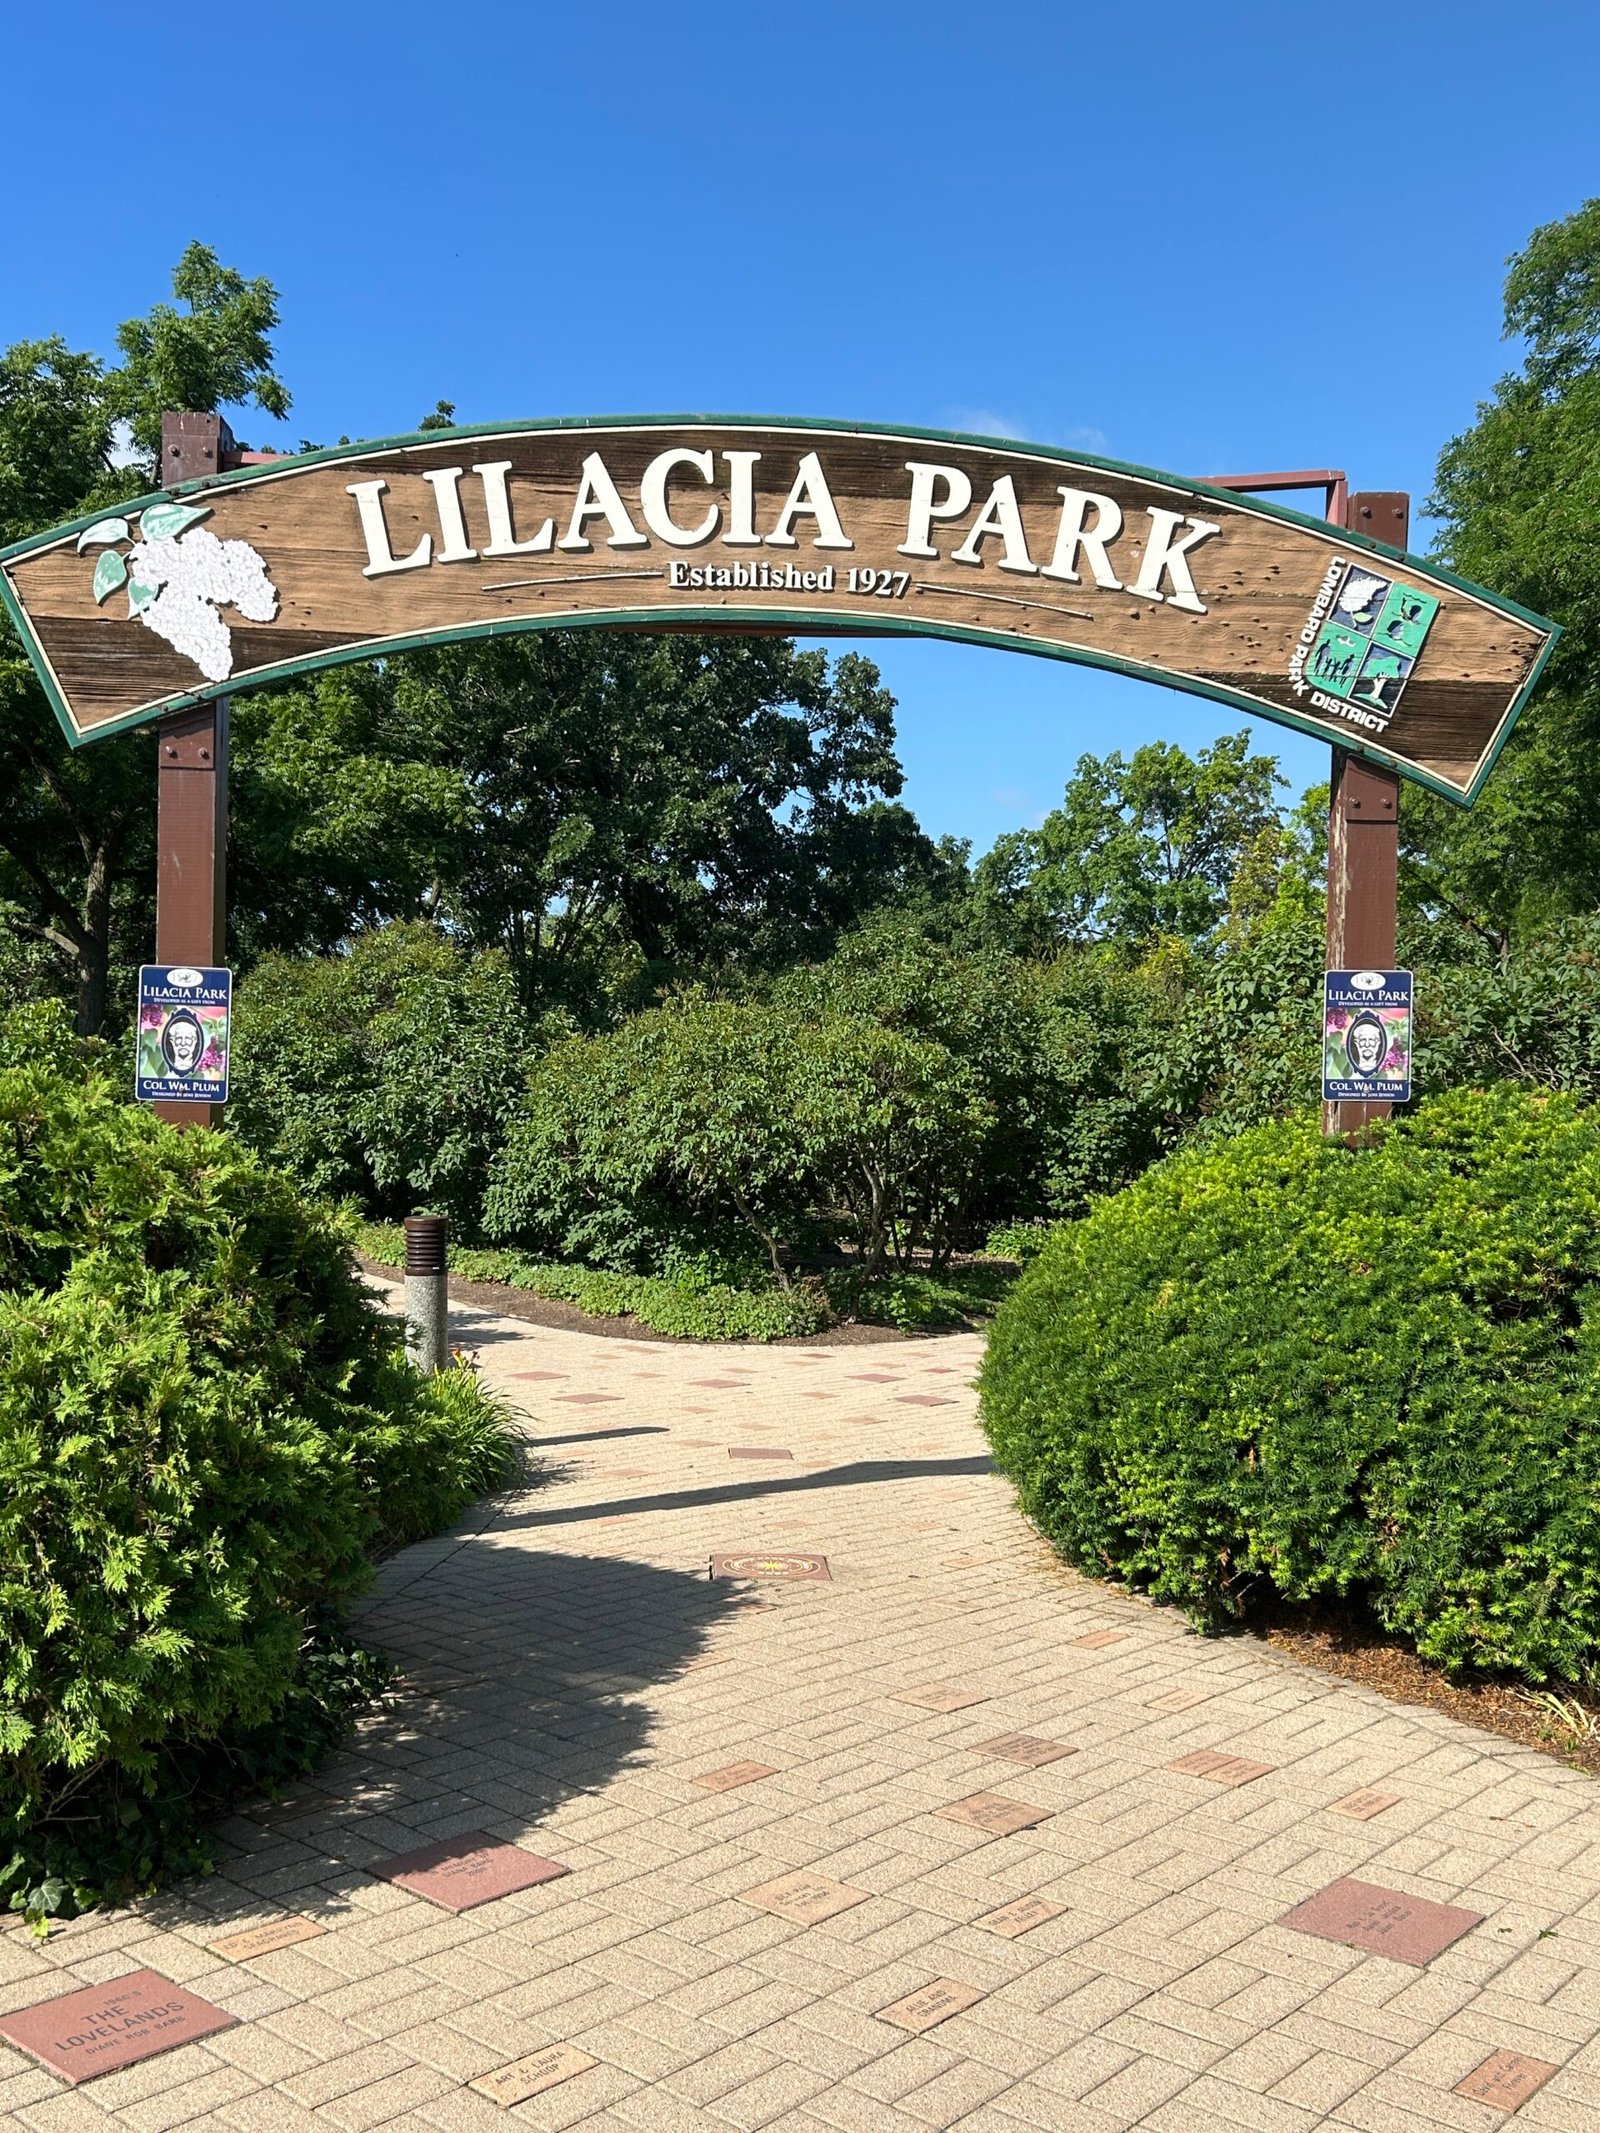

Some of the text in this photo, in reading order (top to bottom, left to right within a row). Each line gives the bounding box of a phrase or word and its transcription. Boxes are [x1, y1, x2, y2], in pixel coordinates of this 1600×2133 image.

[345, 448, 1221, 613] LILACIA PARK
[668, 561, 911, 597] Established 1927
[1288, 556, 1389, 733] LOMBARD PARK DISTRICT
[144, 985, 227, 1000] LILACIA PARK
[1328, 990, 1409, 1001] LILACIA PARK
[193, 1083, 220, 1092] PLUM
[1377, 1082, 1403, 1091] PLUM
[81, 2006, 129, 2026] THE
[55, 2001, 185, 2051] LOVELANDS
[495, 2072, 516, 2085] ART
